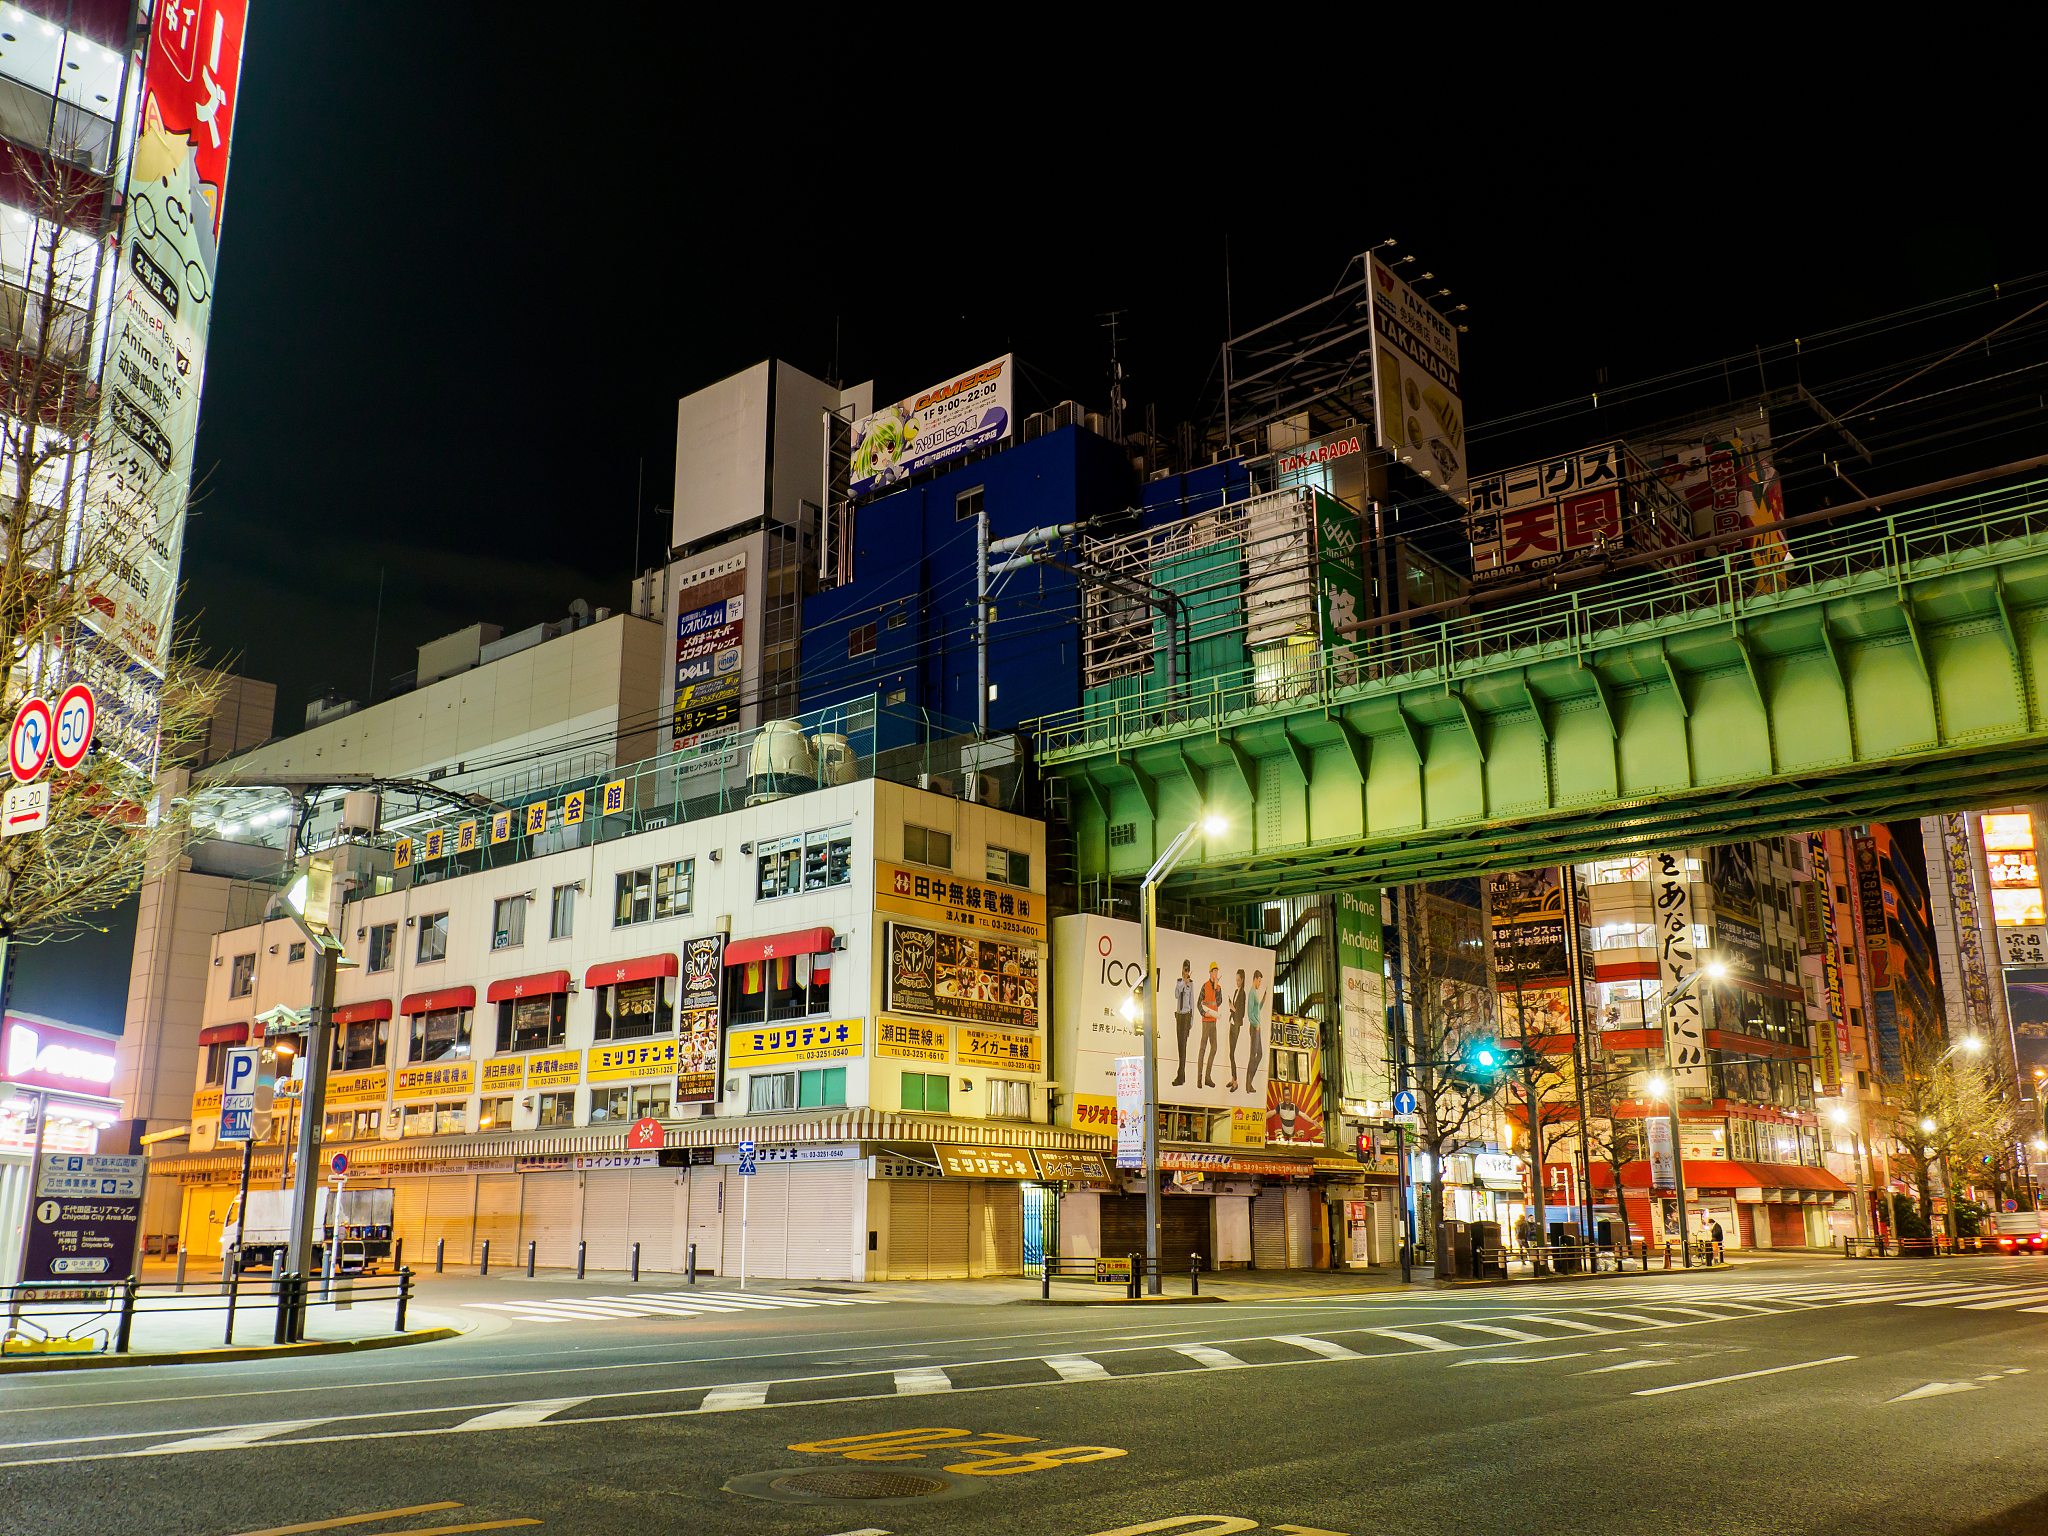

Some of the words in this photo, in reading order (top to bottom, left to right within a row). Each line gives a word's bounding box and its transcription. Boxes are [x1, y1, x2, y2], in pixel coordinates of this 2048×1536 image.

[135, 253, 163, 294] 2号店
[163, 289, 178, 306] 4F
[1401, 288, 1452, 343] TAX-FREE
[122, 323, 160, 371] Anime
[162, 363, 182, 400] Cafe
[1377, 312, 1460, 394] TAKARADA
[914, 360, 1006, 412] GAMERS
[924, 408, 935, 421] 1F
[1279, 436, 1361, 474] TAKARADA
[102, 490, 138, 529] Anime
[682, 558, 742, 586] 秋葉原野村ビル
[1523, 554, 1563, 570] HOBBY
[681, 608, 723, 636] レオパレス21
[678, 636, 739, 662] コンタクトレンズ
[679, 661, 710, 682] DELL
[695, 705, 738, 727] ケーヨー
[61, 708, 85, 746] 50
[396, 784, 622, 865] 秋葉原電波会館
[1860, 872, 1878, 880] ゲーム
[1863, 881, 1877, 889] CD
[914, 875, 1015, 917] 田中無線電機
[1342, 892, 1375, 917] iPhone
[1863, 899, 1882, 907] アニメ
[945, 910, 975, 925] 法人営業
[979, 918, 990, 927] TEL
[991, 919, 1039, 937] 03-3253-4001
[1341, 928, 1379, 953] Android
[1023, 1008, 1039, 1026] 2F
[753, 1023, 849, 1051] ミツワデンキ
[881, 1024, 934, 1046] 瀬田無線
[602, 1045, 675, 1067] ミツワデンキ
[806, 1048, 849, 1060] 03-3251-0540
[891, 1048, 901, 1056] TEL
[902, 1049, 945, 1061] 03-3251-6610
[970, 1038, 1030, 1059] タイガー無線
[230, 1055, 253, 1090] P
[484, 1063, 515, 1079] 瀬田無線
[1008, 1060, 1041, 1071] 03-3251-6313
[408, 1067, 460, 1087] 田中無線電機
[225, 1096, 253, 1109] ダイビル
[235, 1111, 252, 1129] IN
[1245, 1110, 1265, 1122] e-BOX
[585, 1156, 652, 1168] コインロッカー
[947, 1157, 1028, 1175] ミツワデンキ
[1046, 1162, 1104, 1178] タイガー無線
[61, 1213, 89, 1221] Chiyoda
[90, 1213, 105, 1222] City
[62, 1204, 135, 1215] 千代田区エリアマップ
